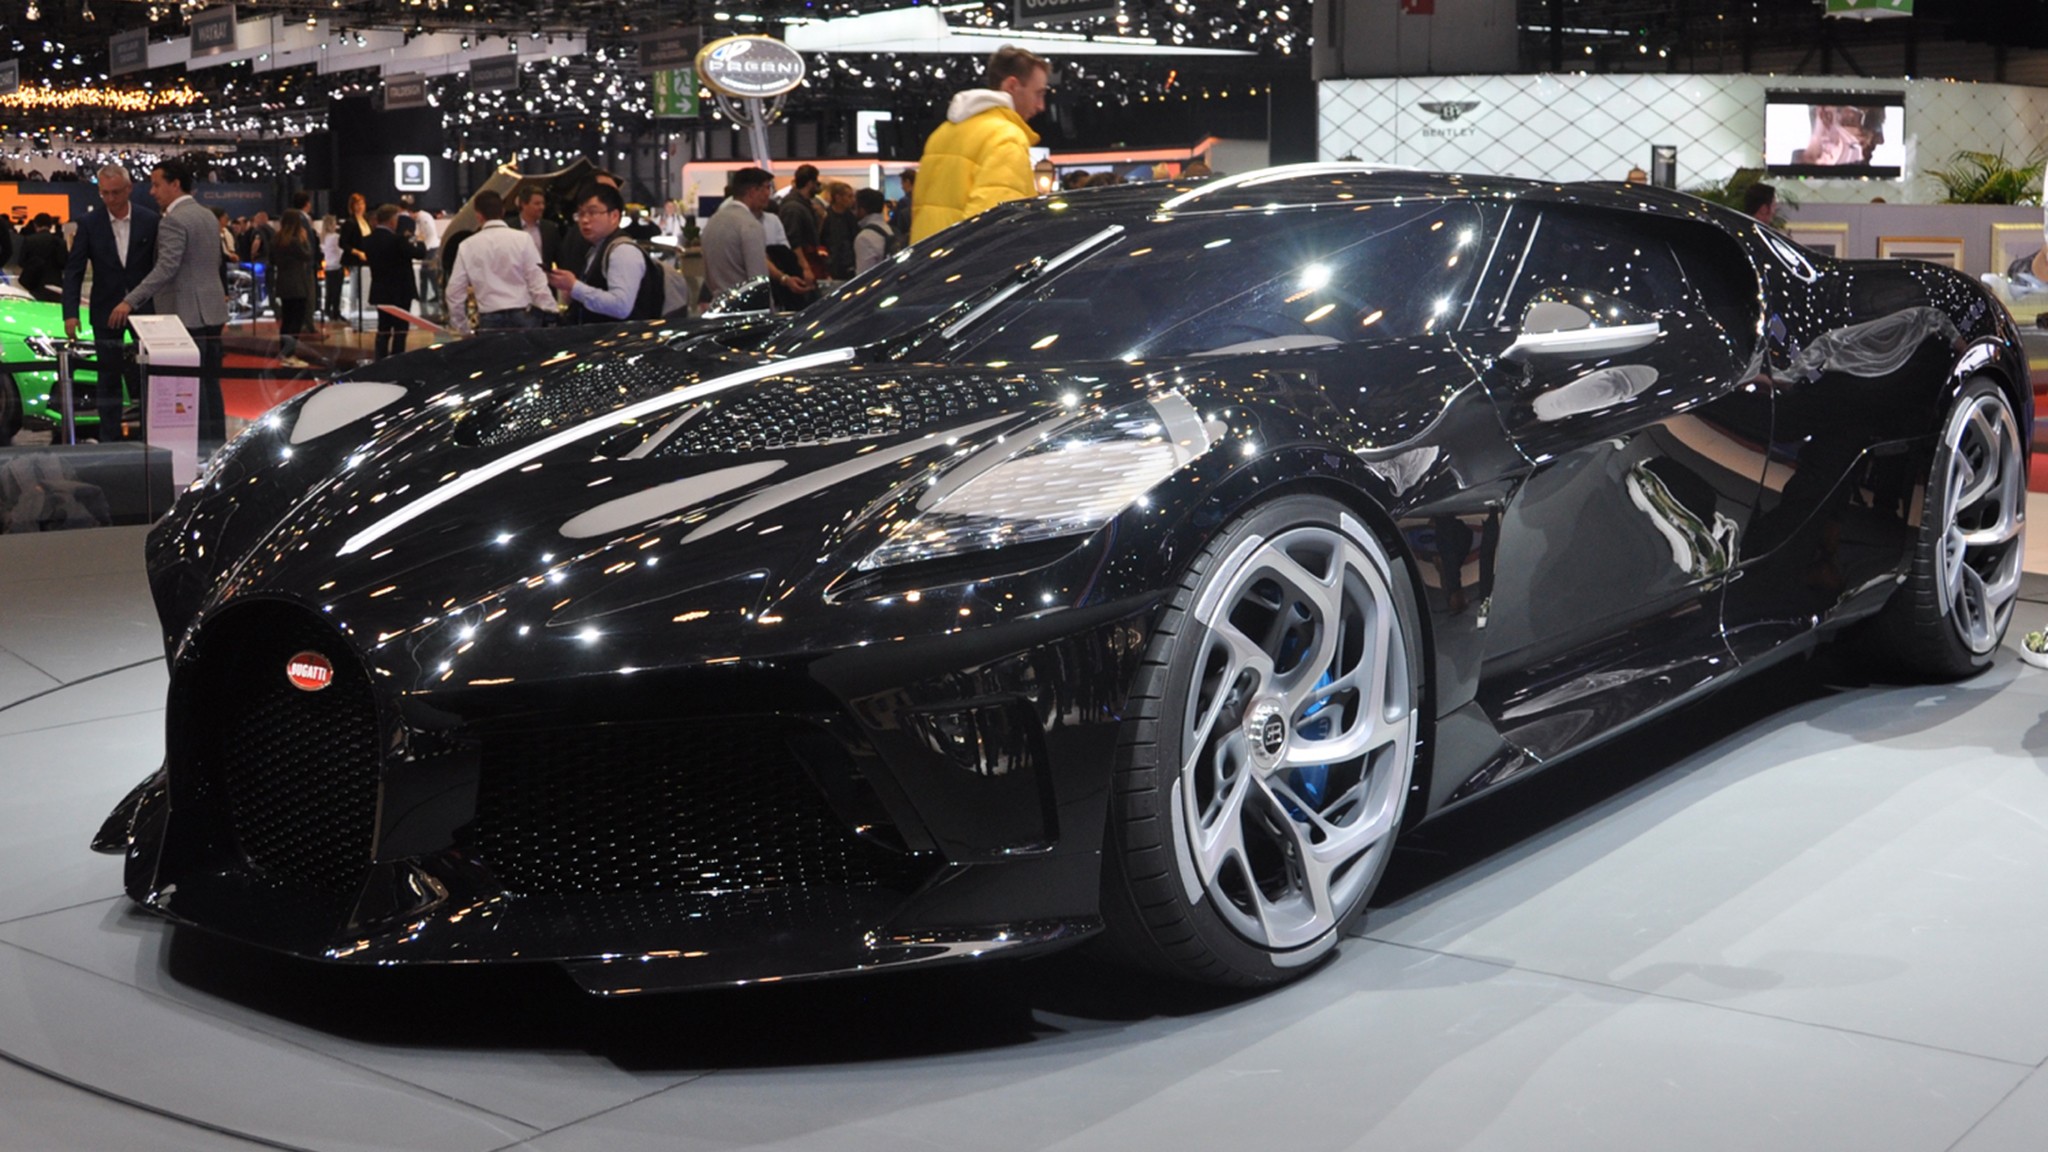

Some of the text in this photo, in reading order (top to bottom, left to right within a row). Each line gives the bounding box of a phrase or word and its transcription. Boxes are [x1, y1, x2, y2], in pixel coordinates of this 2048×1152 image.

[709, 60, 800, 73] PAGANI
[1422, 128, 1475, 137] BENTLEY
[203, 191, 262, 199] CUPRA
[291, 662, 328, 682] BUGATTI
